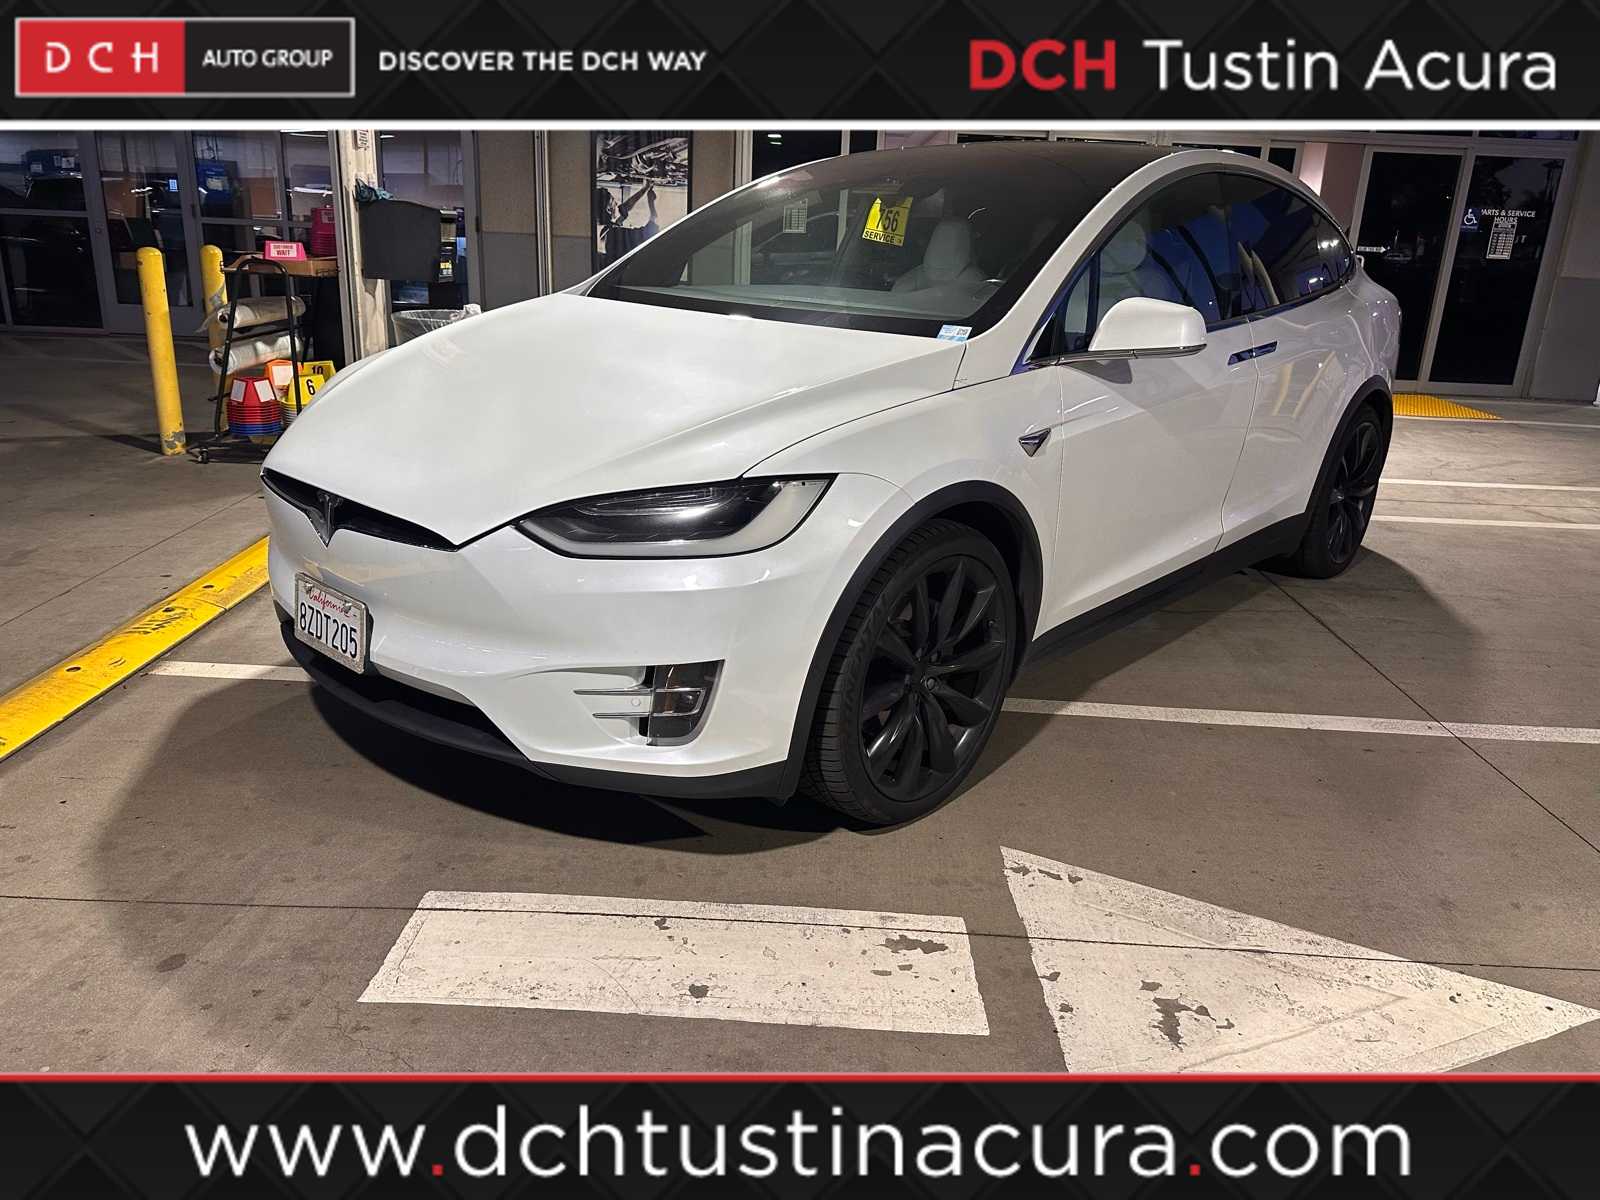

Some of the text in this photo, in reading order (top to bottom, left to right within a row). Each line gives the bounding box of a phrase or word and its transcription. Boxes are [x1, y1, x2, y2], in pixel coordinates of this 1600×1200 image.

[1507, 209, 1536, 218] SERVICE
[863, 230, 895, 243] SERVICE
[306, 378, 316, 396] 6
[300, 602, 358, 659] 8ZDT205
